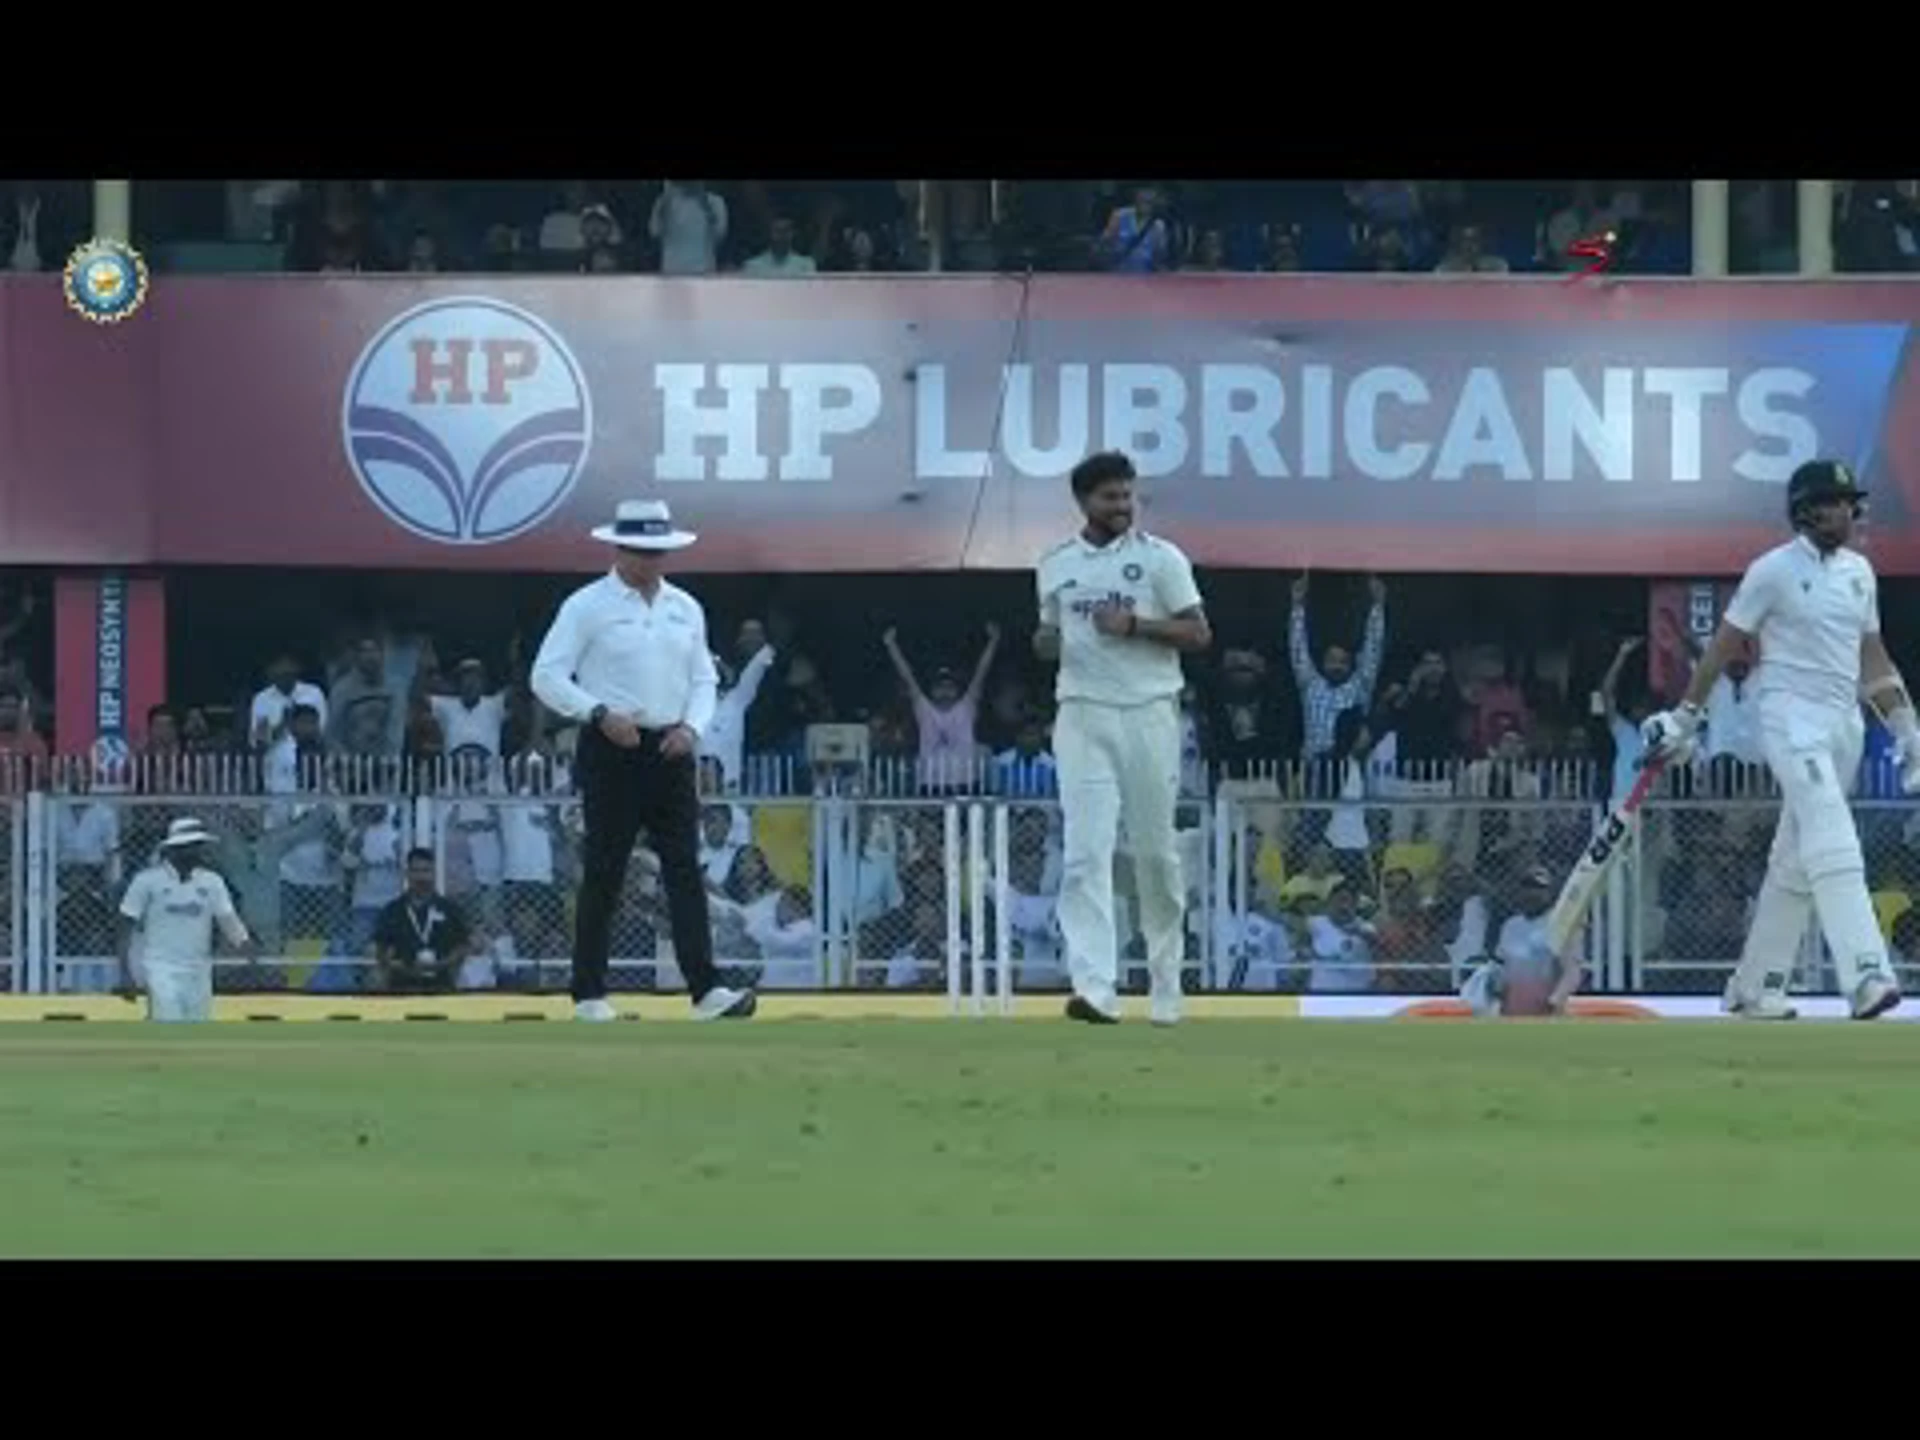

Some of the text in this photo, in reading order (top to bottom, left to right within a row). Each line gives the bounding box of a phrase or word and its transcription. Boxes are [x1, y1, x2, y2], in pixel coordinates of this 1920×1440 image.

[408, 338, 540, 405] HP
[655, 363, 1819, 483] HP LUBRICANTS
